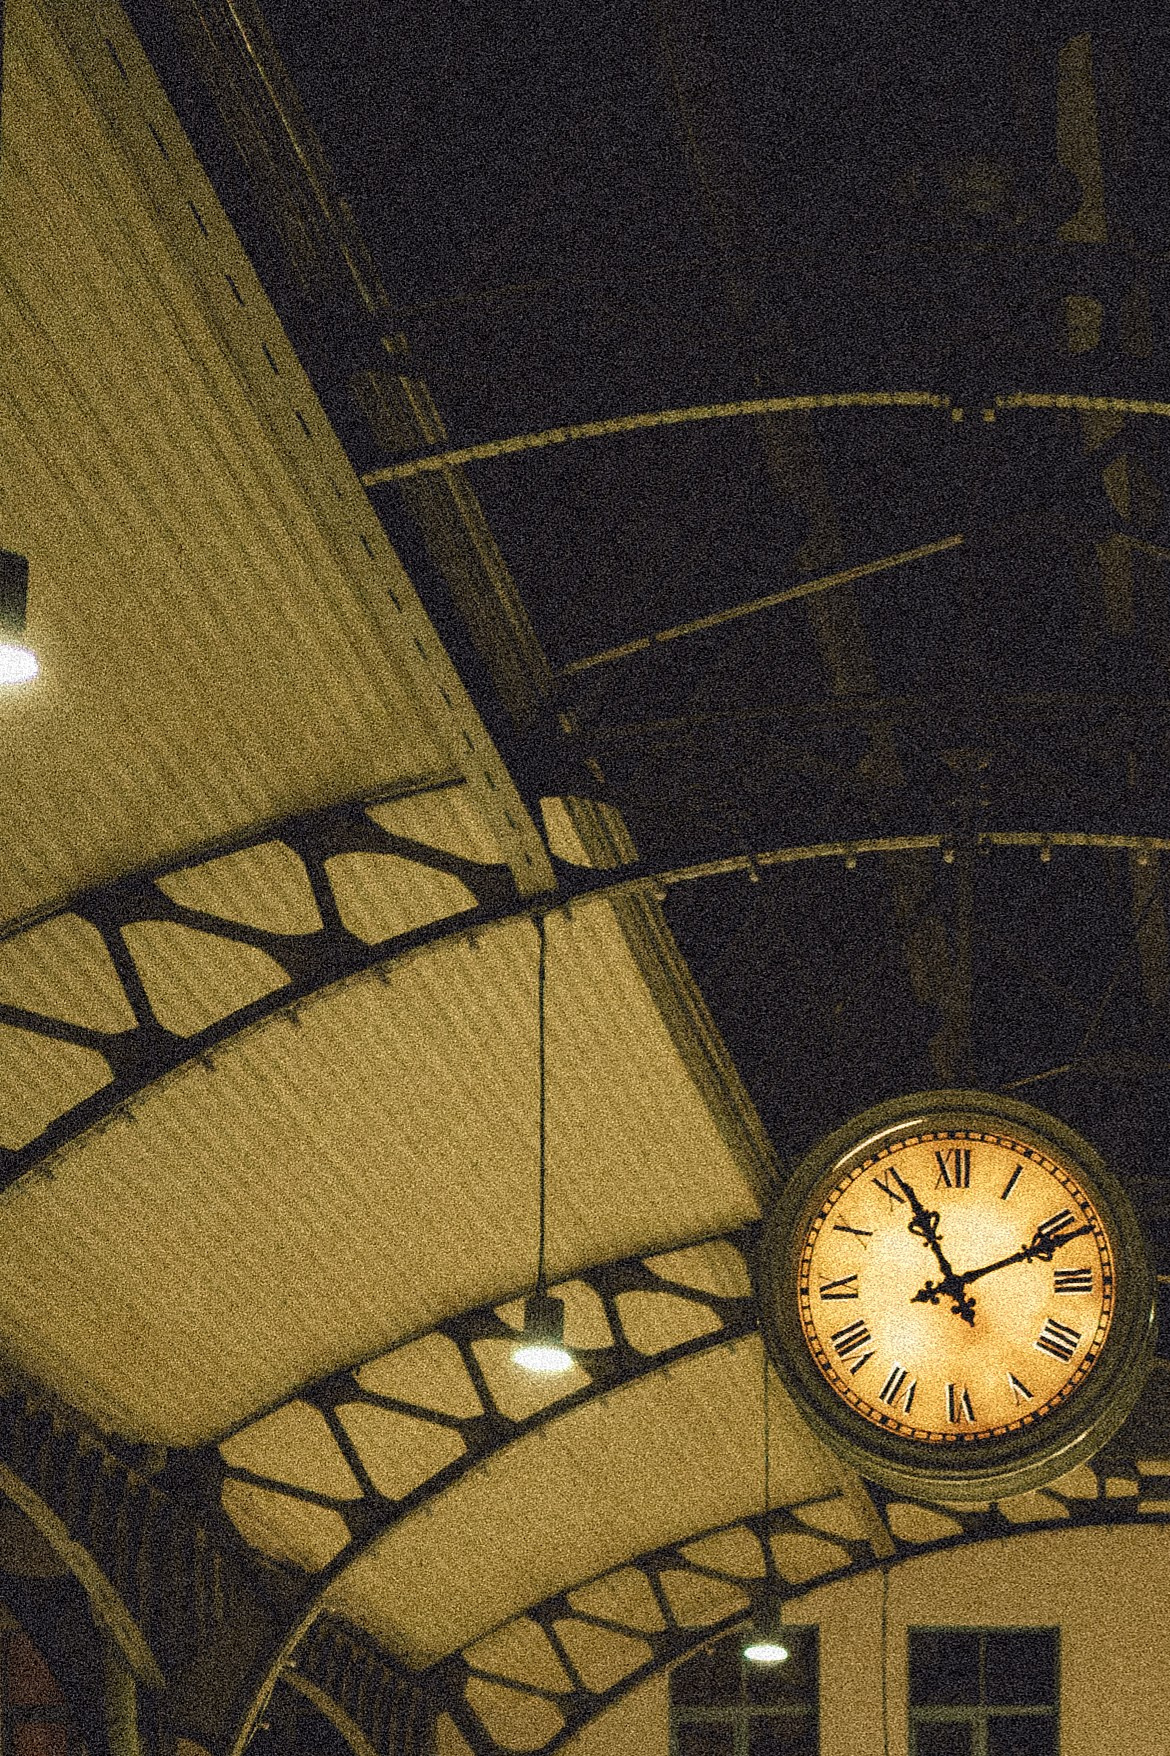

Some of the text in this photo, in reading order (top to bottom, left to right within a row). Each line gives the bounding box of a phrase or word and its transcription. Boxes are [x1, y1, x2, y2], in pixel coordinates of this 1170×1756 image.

[935, 1148, 971, 1189] XII
[1001, 1164, 1023, 1200] I
[833, 1214, 872, 1249] X
[819, 1273, 859, 1301] IX
[1053, 1267, 1093, 1295] III
[830, 1318, 876, 1375] VIII
[1034, 1317, 1082, 1363] IIII
[879, 1365, 916, 1415] VII
[944, 1382, 975, 1424] VI
[1006, 1371, 1034, 1407] V
